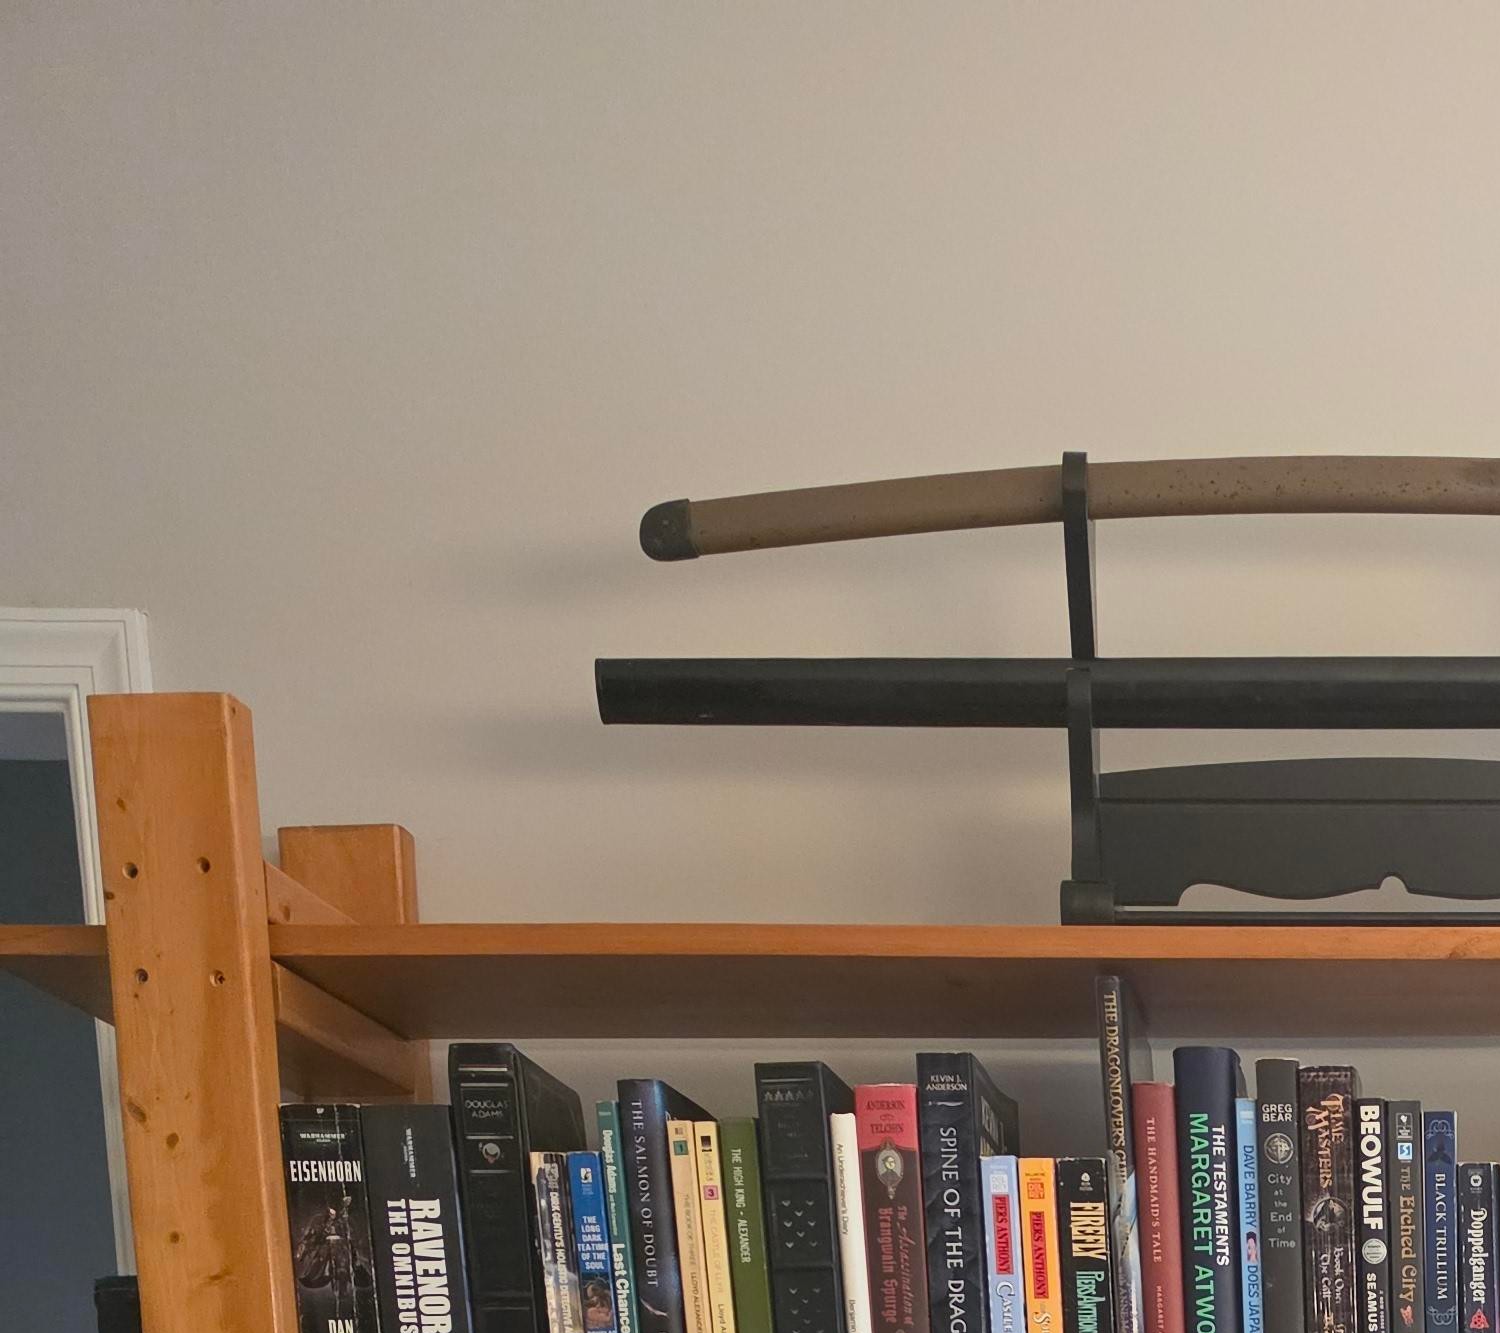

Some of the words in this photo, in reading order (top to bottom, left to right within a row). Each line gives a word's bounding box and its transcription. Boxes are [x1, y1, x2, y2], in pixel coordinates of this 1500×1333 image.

[290, 1160, 361, 1182] EISENHORN
[939, 1127, 957, 1181] SPINE
[1243, 1145, 1255, 1175] DAVE
[1359, 1105, 1385, 1231] BEOWULF
[941, 1187, 960, 1218] OF
[1189, 1112, 1213, 1255] MARGARET
[1244, 1178, 1257, 1229] BARRY
[387, 1199, 408, 1236] THE
[945, 1227, 962, 1269] THE
[1466, 1207, 1488, 1304] Doppelganger
